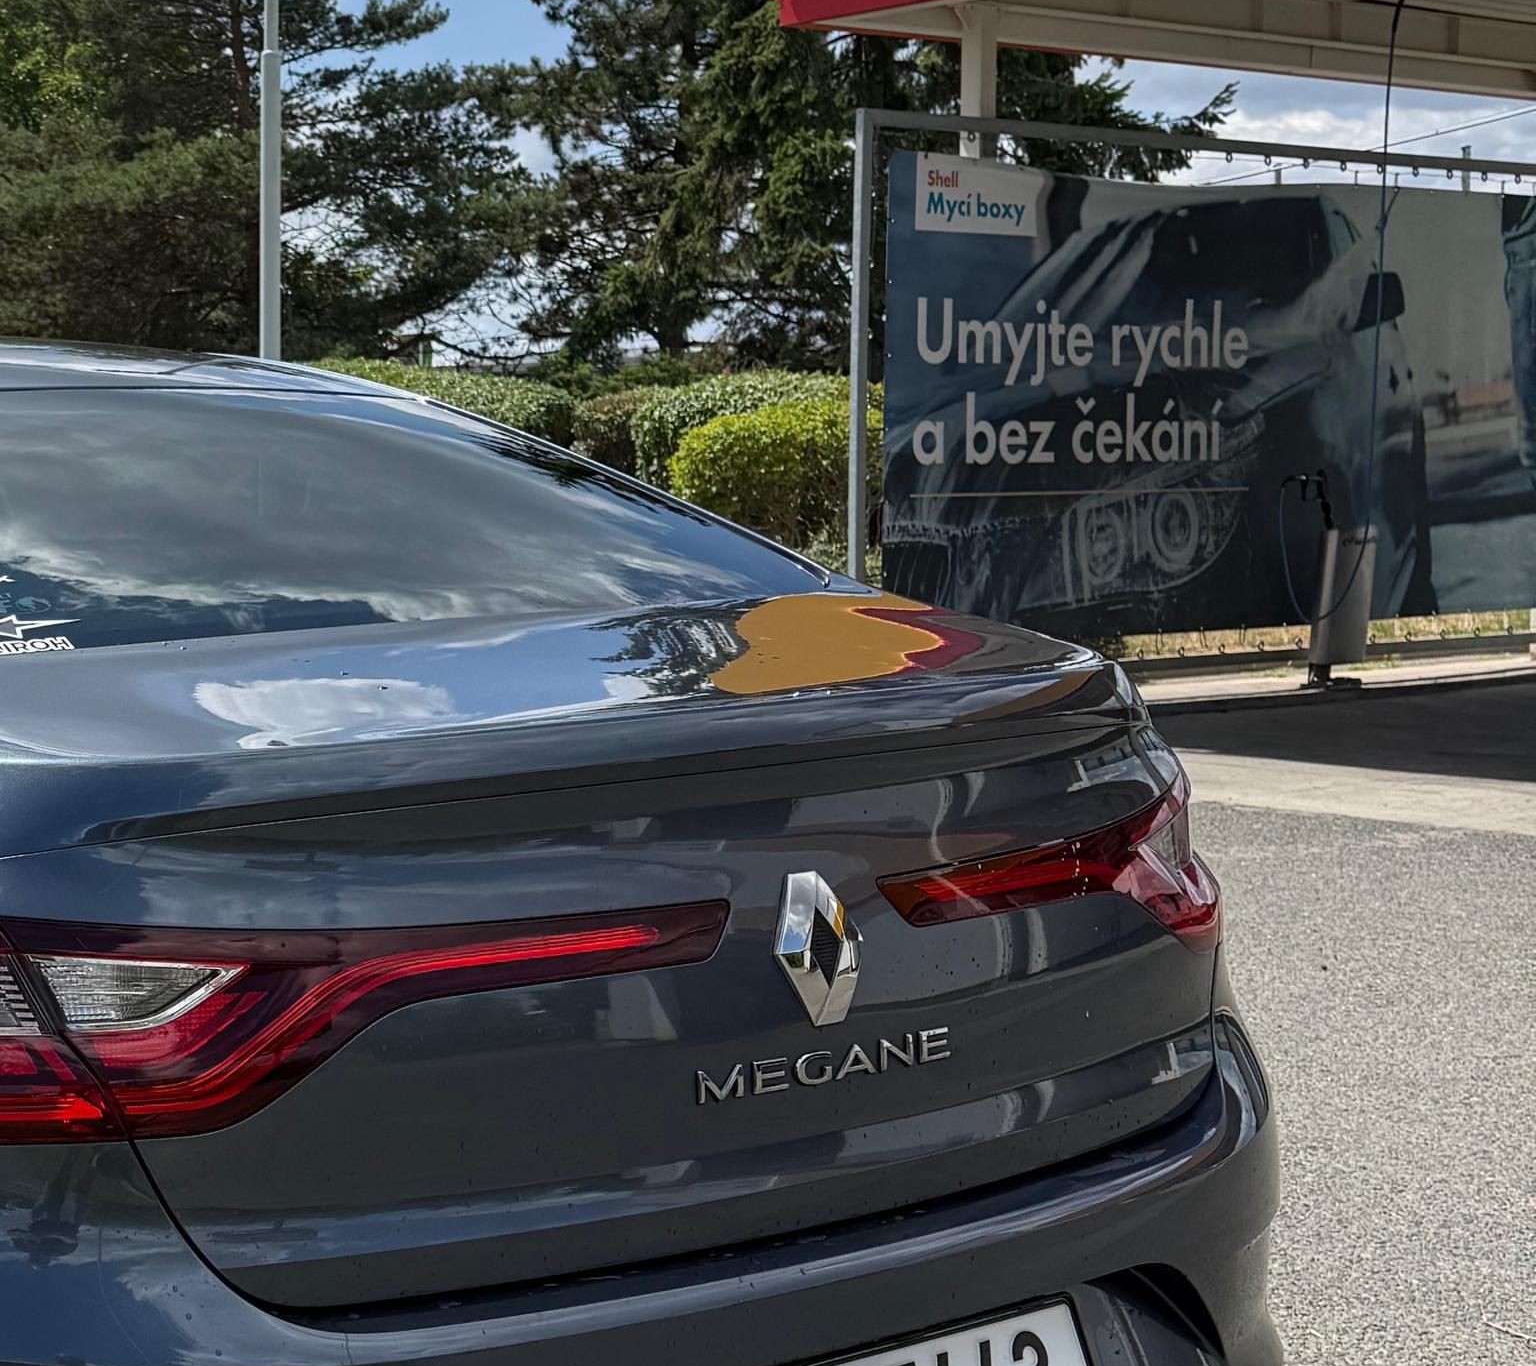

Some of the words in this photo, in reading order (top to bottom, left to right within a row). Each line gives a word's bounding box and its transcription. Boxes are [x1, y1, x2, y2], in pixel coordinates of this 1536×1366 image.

[926, 191, 972, 223] Mycí
[976, 192, 1026, 227] boxy
[927, 169, 959, 188] Shell
[915, 296, 1094, 386] Umyjte
[1111, 298, 1250, 387] rychle
[911, 420, 945, 466] a
[964, 392, 1055, 465] bez
[1071, 393, 1224, 464] čekání
[695, 1026, 952, 1105] MEGANE
